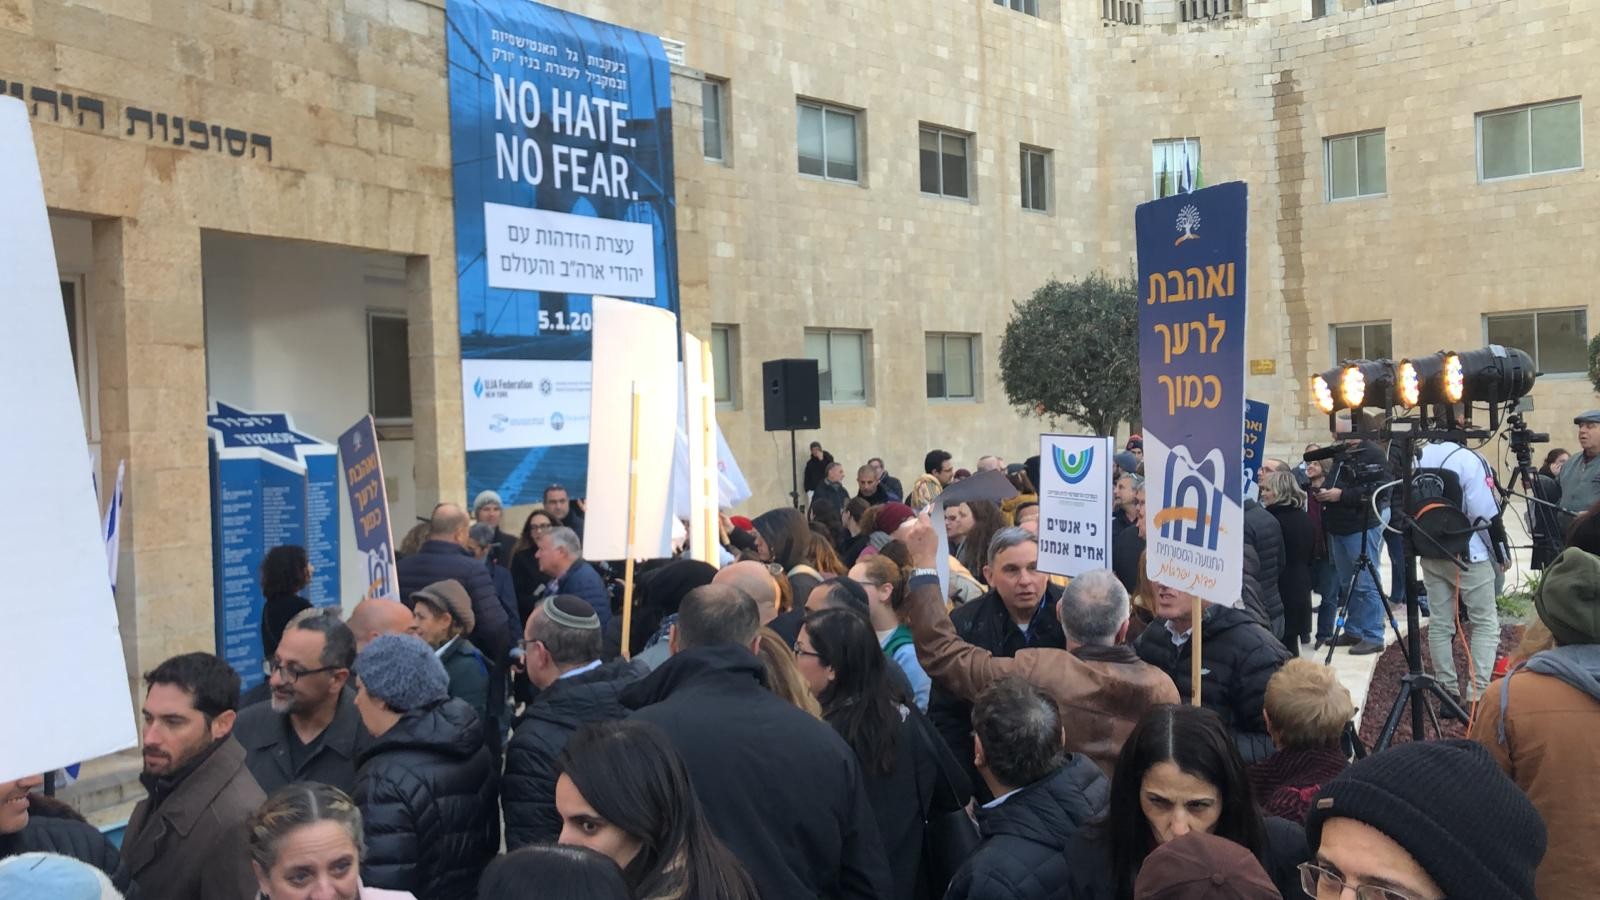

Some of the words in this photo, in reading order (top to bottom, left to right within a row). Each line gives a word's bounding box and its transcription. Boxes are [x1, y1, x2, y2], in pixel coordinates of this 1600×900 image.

[492, 48, 515, 63] יורק
[520, 55, 540, 70] בניו
[565, 47, 579, 62] גל
[587, 55, 627, 74] בעקבות
[545, 62, 580, 80] לעצרת
[585, 69, 627, 90] ובמקביל
[493, 72, 541, 129] NO
[552, 87, 637, 148] HATE.
[126, 106, 272, 162] הסוכנות
[495, 132, 544, 187] NO
[552, 143, 638, 200] FEAR.
[508, 224, 530, 244] עם
[535, 228, 591, 249] הזדהות
[595, 236, 634, 255] עצרת
[500, 252, 554, 275] והעולם
[609, 265, 644, 282] יהודי
[1147, 262, 1235, 305] ואהבת
[1154, 312, 1226, 364] לרעך
[484, 379, 497, 390] UJA
[499, 378, 533, 390] Federation
[1158, 374, 1222, 416] כמוך
[349, 453, 378, 486] ואהבת
[354, 479, 379, 511] לרעך
[360, 509, 382, 538] כמוך
[1047, 517, 1081, 534] אנשים
[1086, 522, 1097, 537] כי
[1040, 539, 1069, 555] אנחנו
[1074, 544, 1104, 561] אחים
[1194, 552, 1225, 572] התנועה
